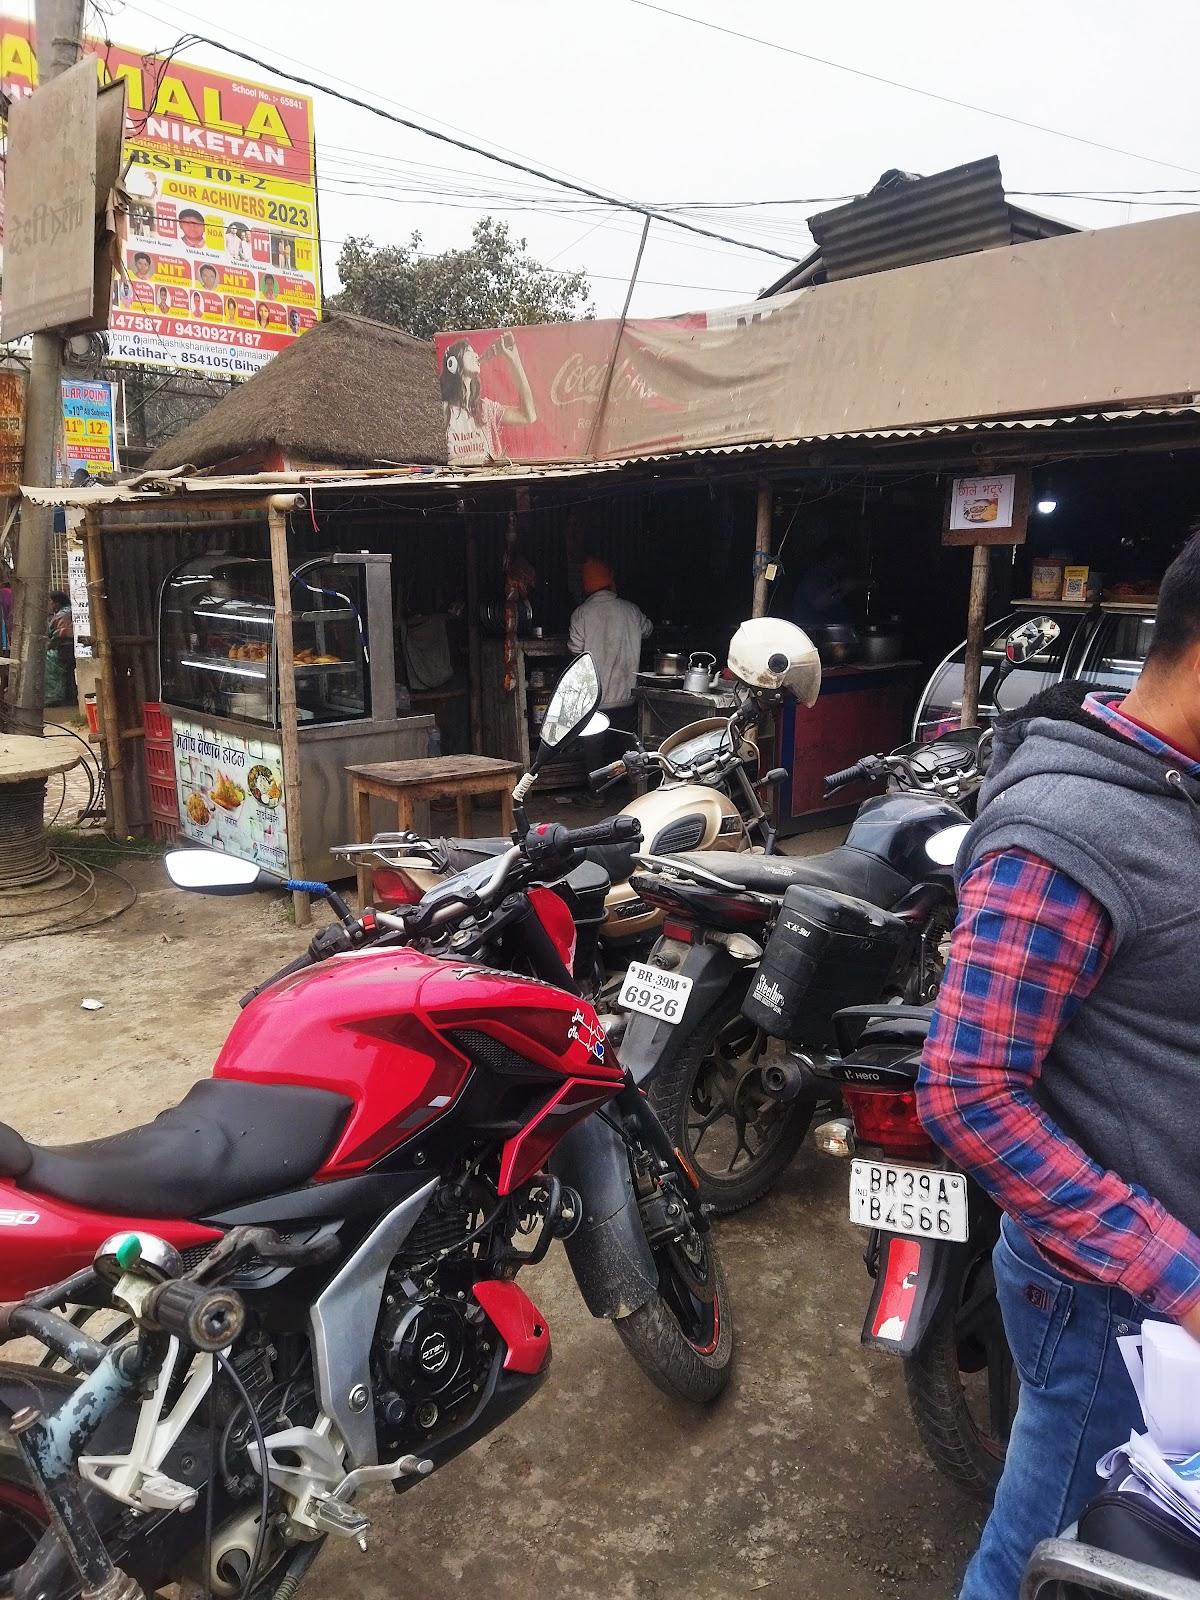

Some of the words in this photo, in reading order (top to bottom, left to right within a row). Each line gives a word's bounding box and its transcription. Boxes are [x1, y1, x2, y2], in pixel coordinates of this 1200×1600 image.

[231, 83, 257, 97] School
[279, 96, 303, 109] 65841
[147, 116, 285, 166] NIKETAN
[124, 148, 191, 174] BSE
[205, 165, 267, 190] 10+2
[169, 182, 198, 199] OUR
[201, 187, 266, 219] ACHIVERS
[267, 200, 309, 228] 2023
[253, 238, 270, 252] IIT
[296, 247, 312, 260] IIT
[157, 262, 185, 277] NIT
[223, 273, 249, 288] NIT
[174, 321, 262, 347] 9430927187
[119, 345, 168, 360] Katihar
[83, 388, 109, 402] POINT
[65, 420, 83, 433] 11th
[89, 421, 108, 435] 12th
[222, 741, 245, 768] होटल
[624, 985, 679, 1018] 6926
[856, 1072, 880, 1081] Hero
[869, 1197, 951, 1235] B4566
